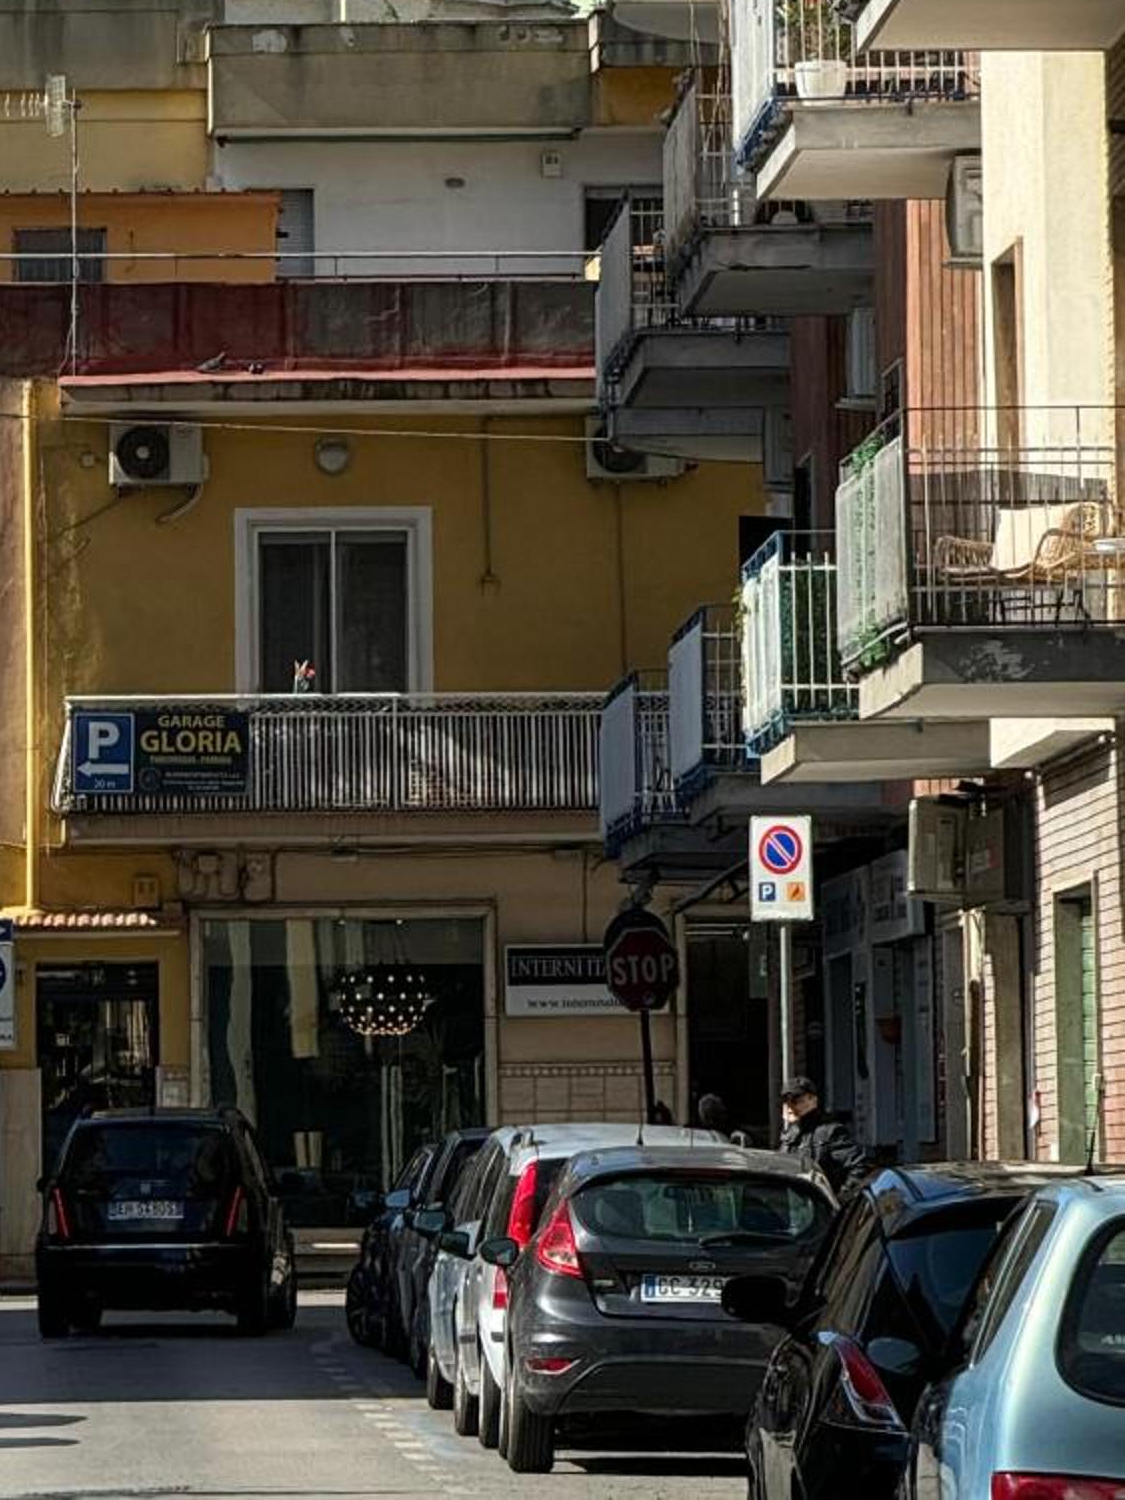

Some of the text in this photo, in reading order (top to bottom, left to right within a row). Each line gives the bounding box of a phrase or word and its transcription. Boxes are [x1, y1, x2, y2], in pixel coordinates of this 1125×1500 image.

[158, 715, 225, 728] GARAGE
[88, 721, 120, 760] P
[140, 730, 242, 753] GLORIA
[762, 884, 773, 899] P
[511, 956, 583, 977] INTERNI
[613, 954, 675, 986] STOP
